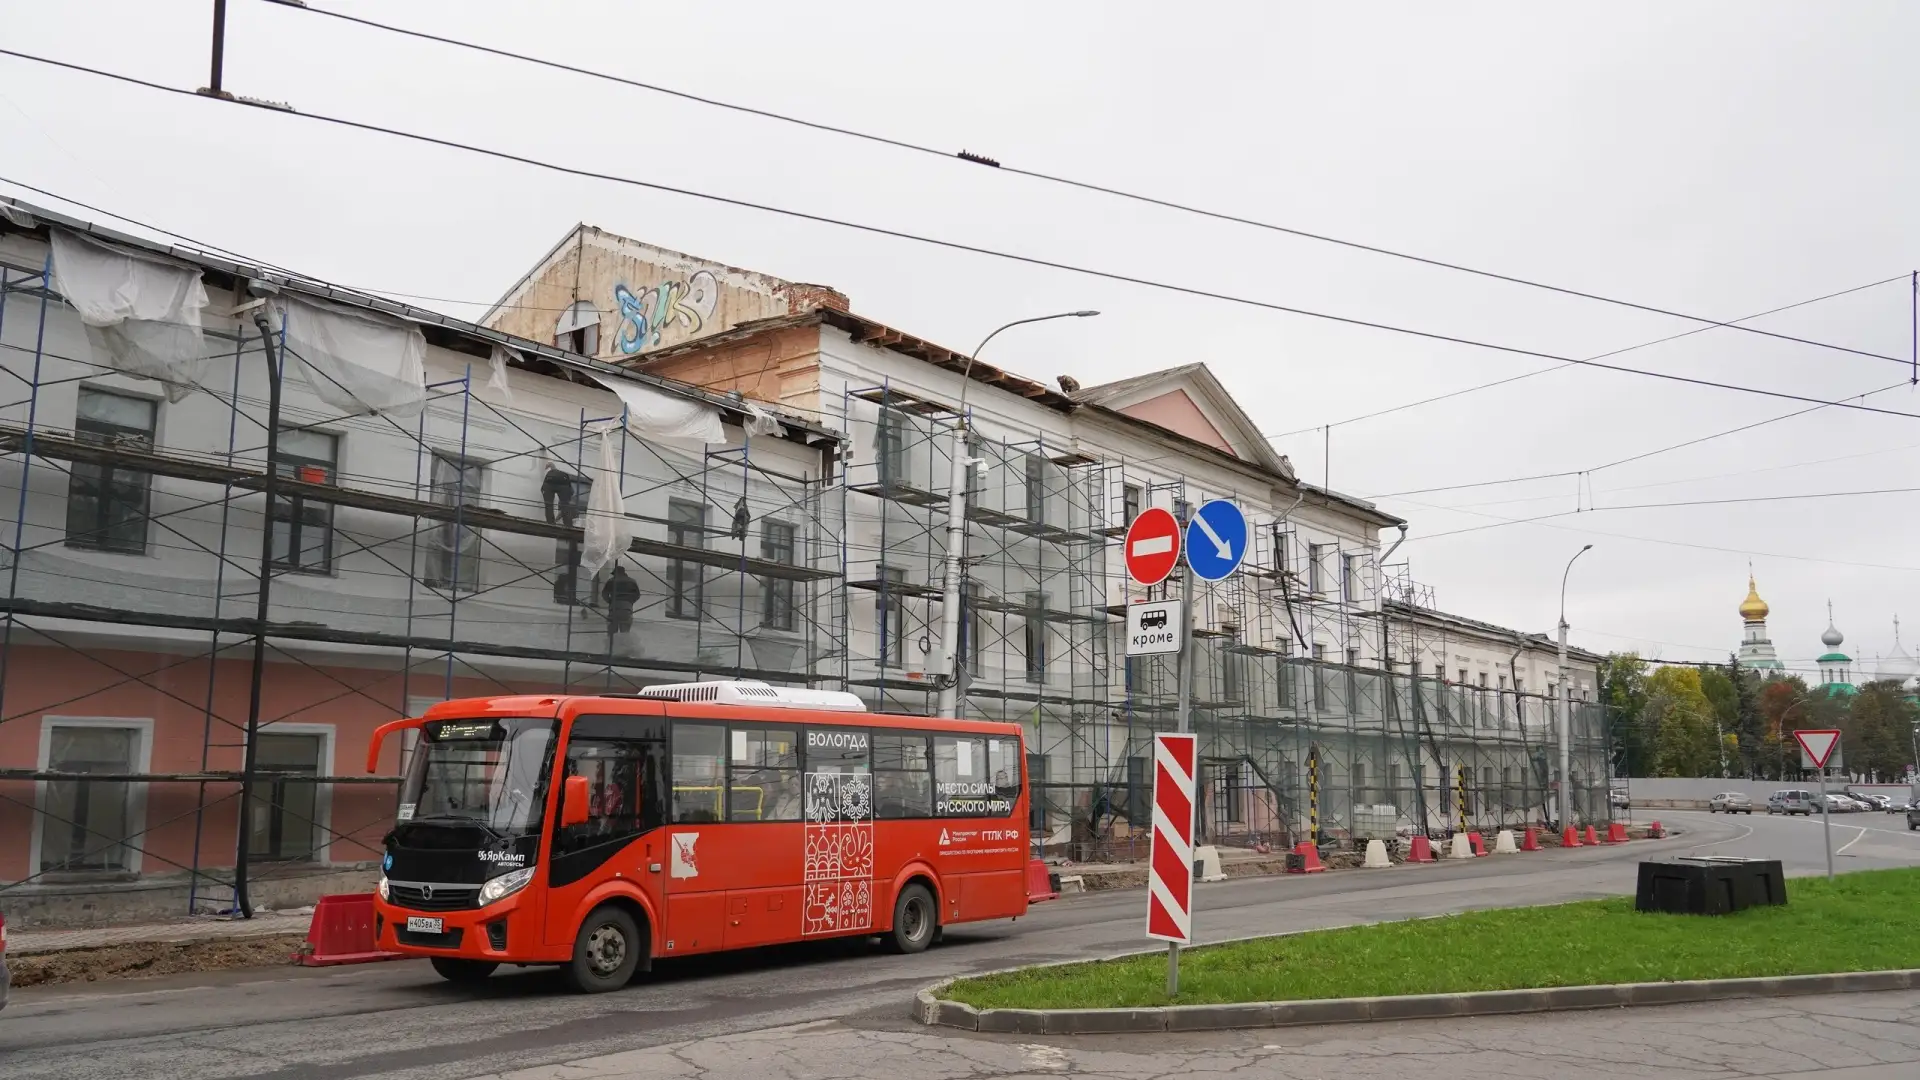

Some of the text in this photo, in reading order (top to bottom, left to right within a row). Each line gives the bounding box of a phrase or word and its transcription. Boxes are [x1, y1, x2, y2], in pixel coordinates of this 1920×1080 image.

[1132, 633, 1173, 648] кроме
[808, 732, 868, 751] ВОЛОГДА
[936, 782, 996, 794] МЕСТО СИЛЫ
[937, 800, 1011, 813] РУССКОГО МИРА
[982, 829, 1019, 841] ГТЛК РФ
[486, 850, 525, 862] ЯрКамп
